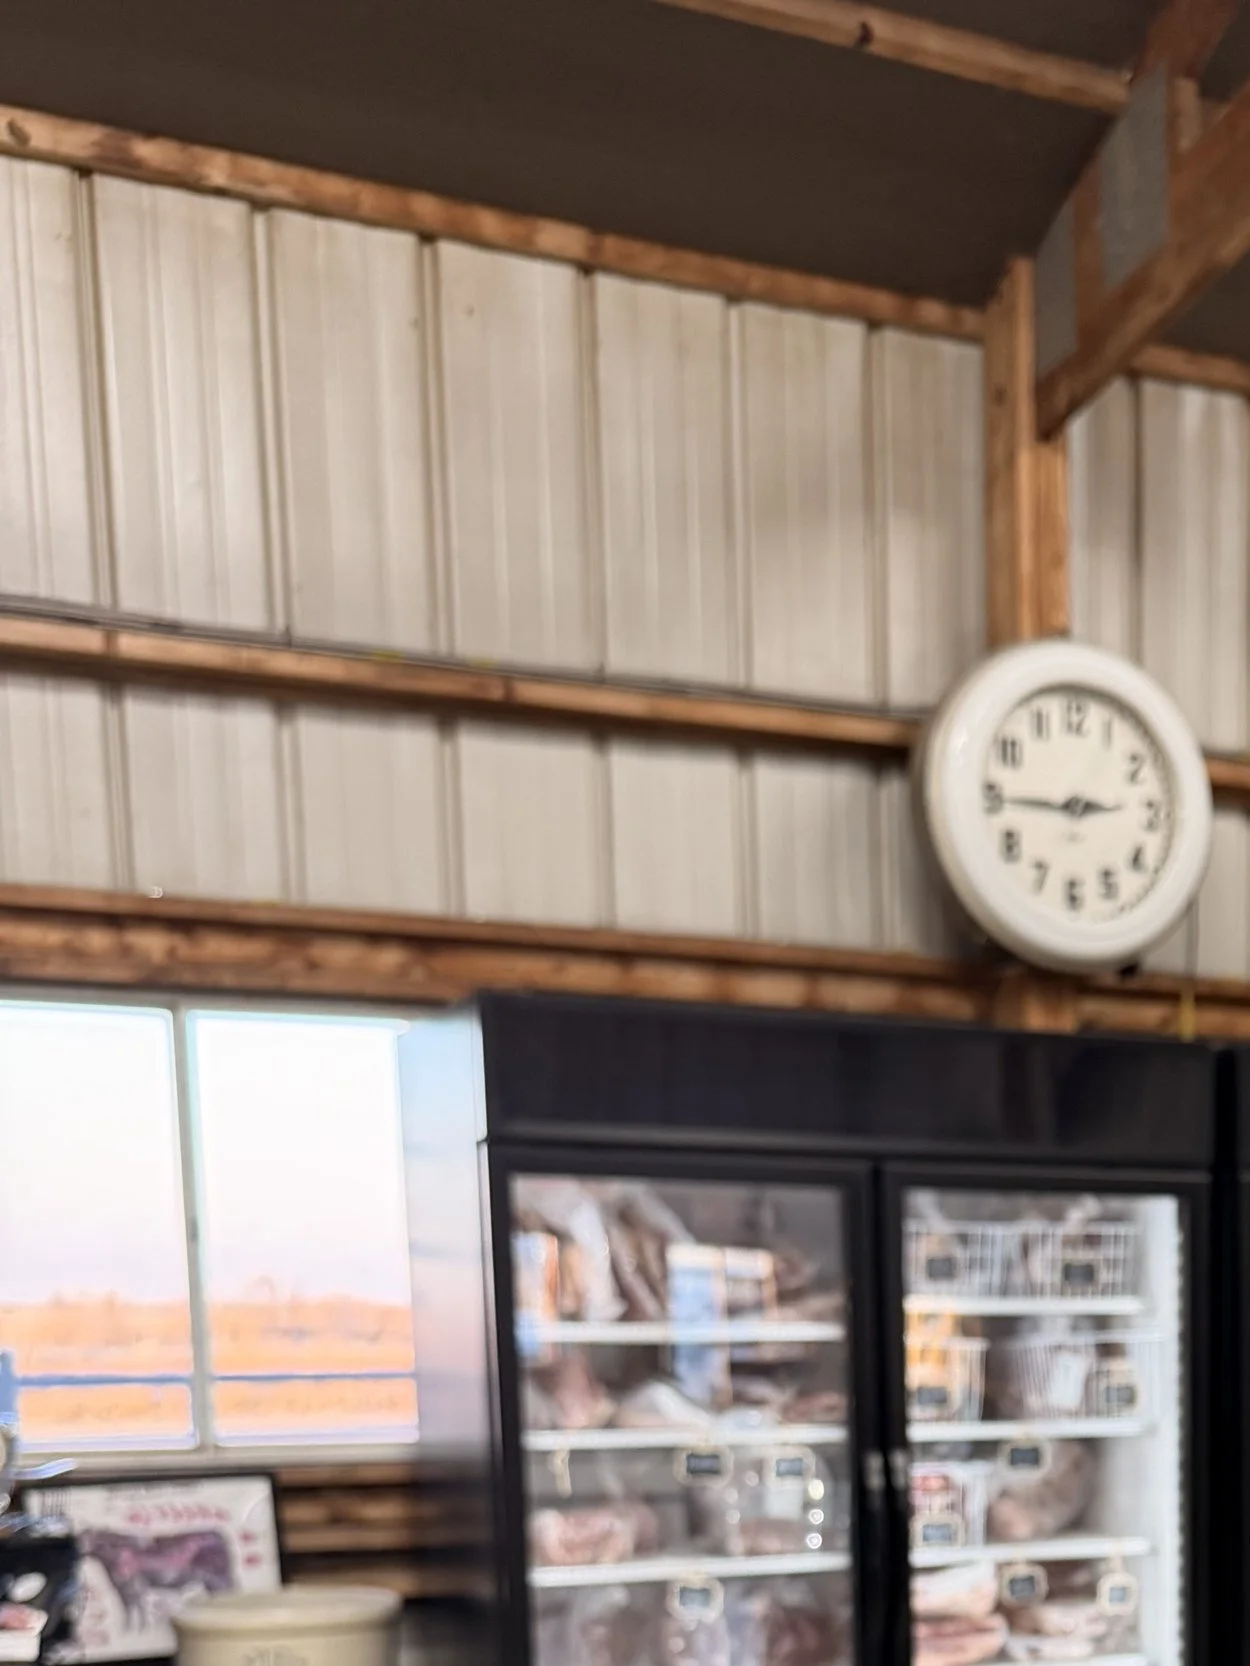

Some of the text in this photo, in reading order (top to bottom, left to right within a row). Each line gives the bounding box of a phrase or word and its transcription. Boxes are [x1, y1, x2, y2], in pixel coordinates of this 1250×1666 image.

[1031, 706, 1050, 740] 11
[1064, 701, 1090, 737] 12
[1102, 717, 1113, 746] 1
[998, 735, 1024, 766] 10
[1126, 752, 1143, 785] 2
[983, 782, 1003, 812] 9
[1143, 800, 1158, 831] 3
[1003, 829, 1021, 863] 8
[1128, 844, 1146, 871] 4
[1031, 860, 1049, 893] 7
[1099, 867, 1118, 899] 5
[1064, 877, 1082, 911] 6
